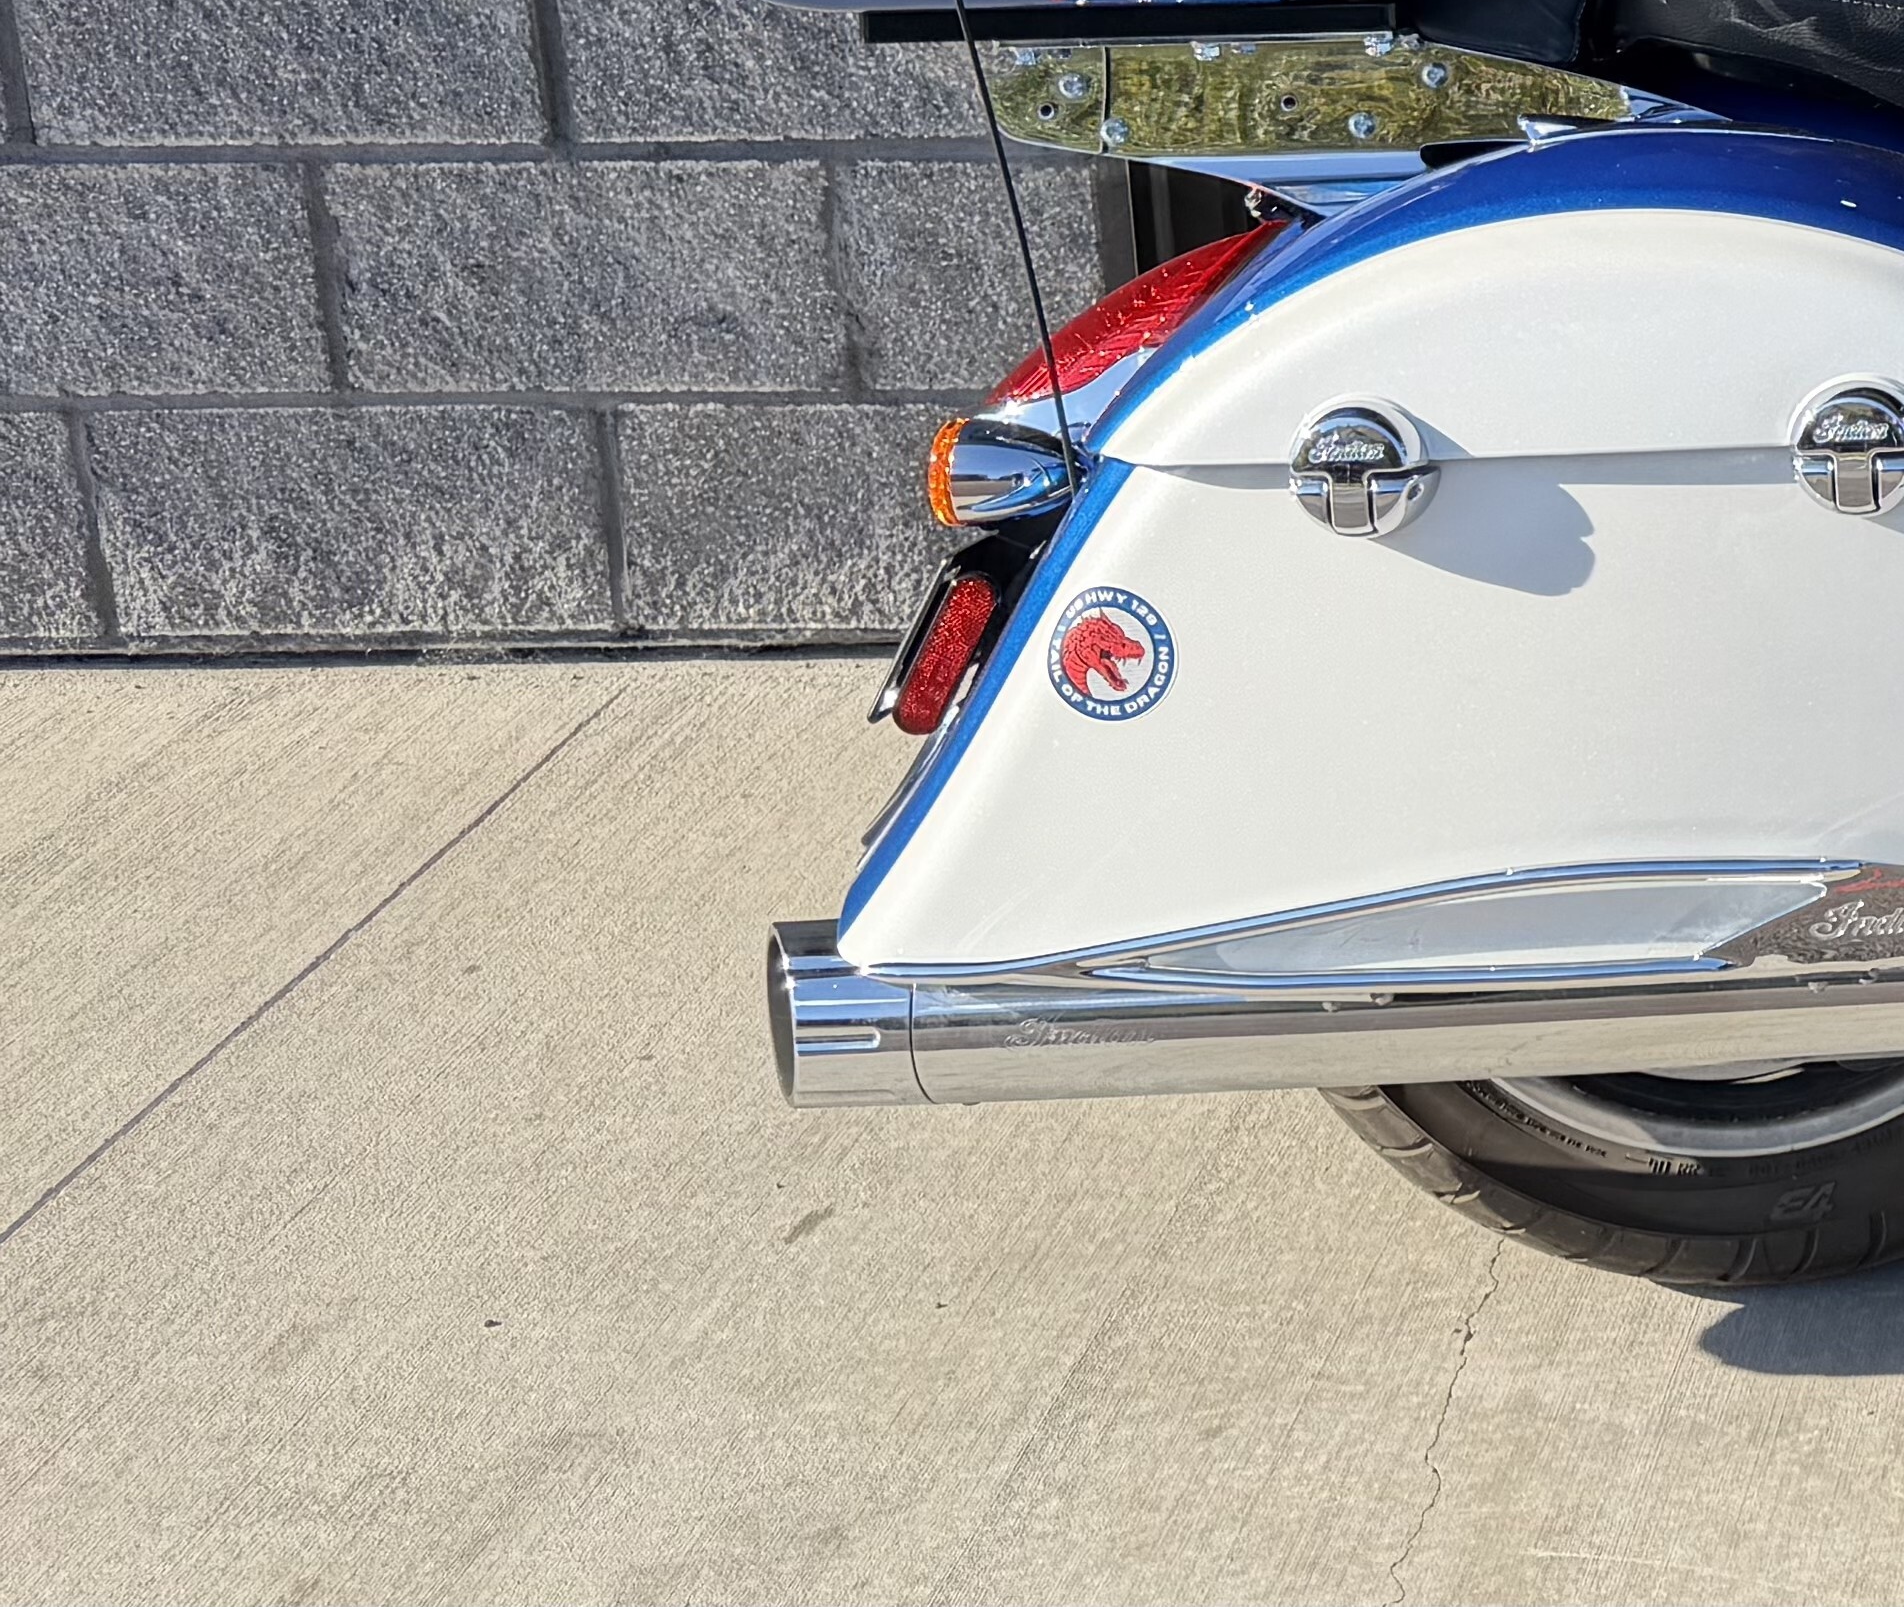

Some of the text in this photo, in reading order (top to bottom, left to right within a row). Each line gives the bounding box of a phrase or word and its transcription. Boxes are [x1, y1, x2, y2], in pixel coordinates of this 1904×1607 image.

[1085, 590, 1127, 605] HWY
[1050, 638, 1170, 716] TAIL OF THE DRAGON
